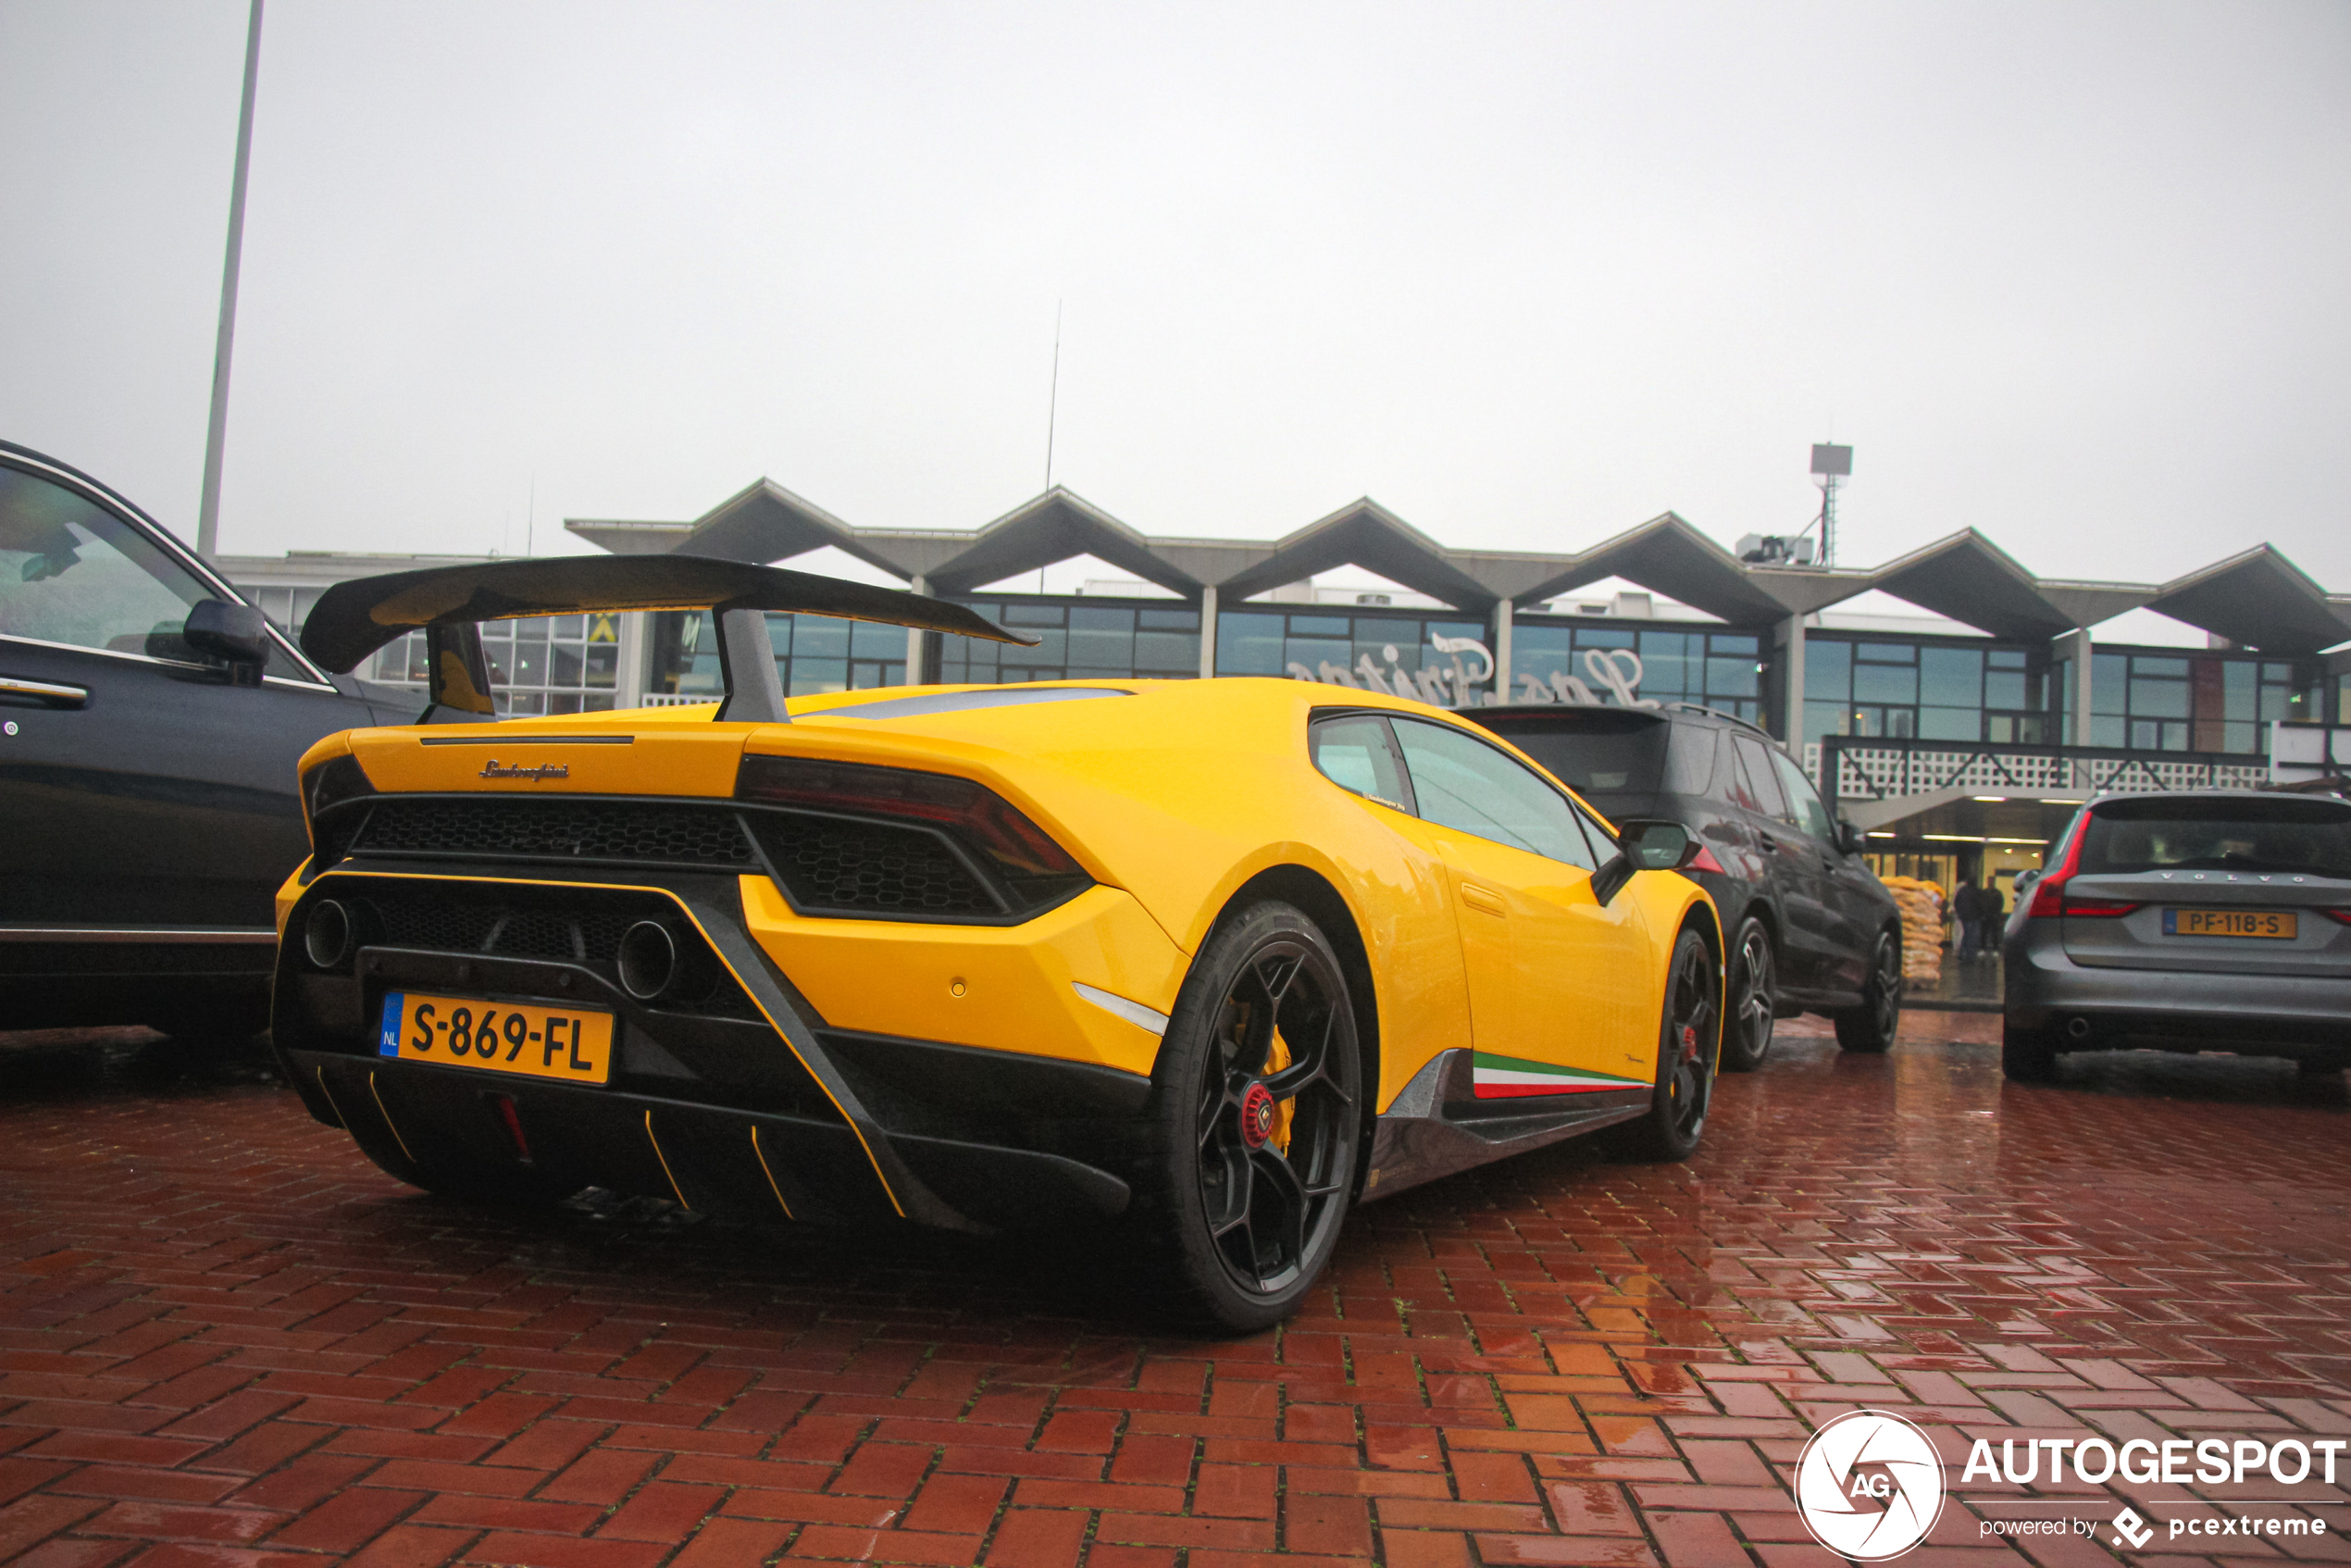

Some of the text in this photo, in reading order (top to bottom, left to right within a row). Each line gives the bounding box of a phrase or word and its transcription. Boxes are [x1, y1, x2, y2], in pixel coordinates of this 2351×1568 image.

[479, 759, 569, 782] Lamborghini
[2161, 873, 2305, 883] VOLVO
[2190, 914, 2280, 934] PF-118-S
[383, 1031, 397, 1047] NL
[412, 1003, 592, 1071] S-869-FL
